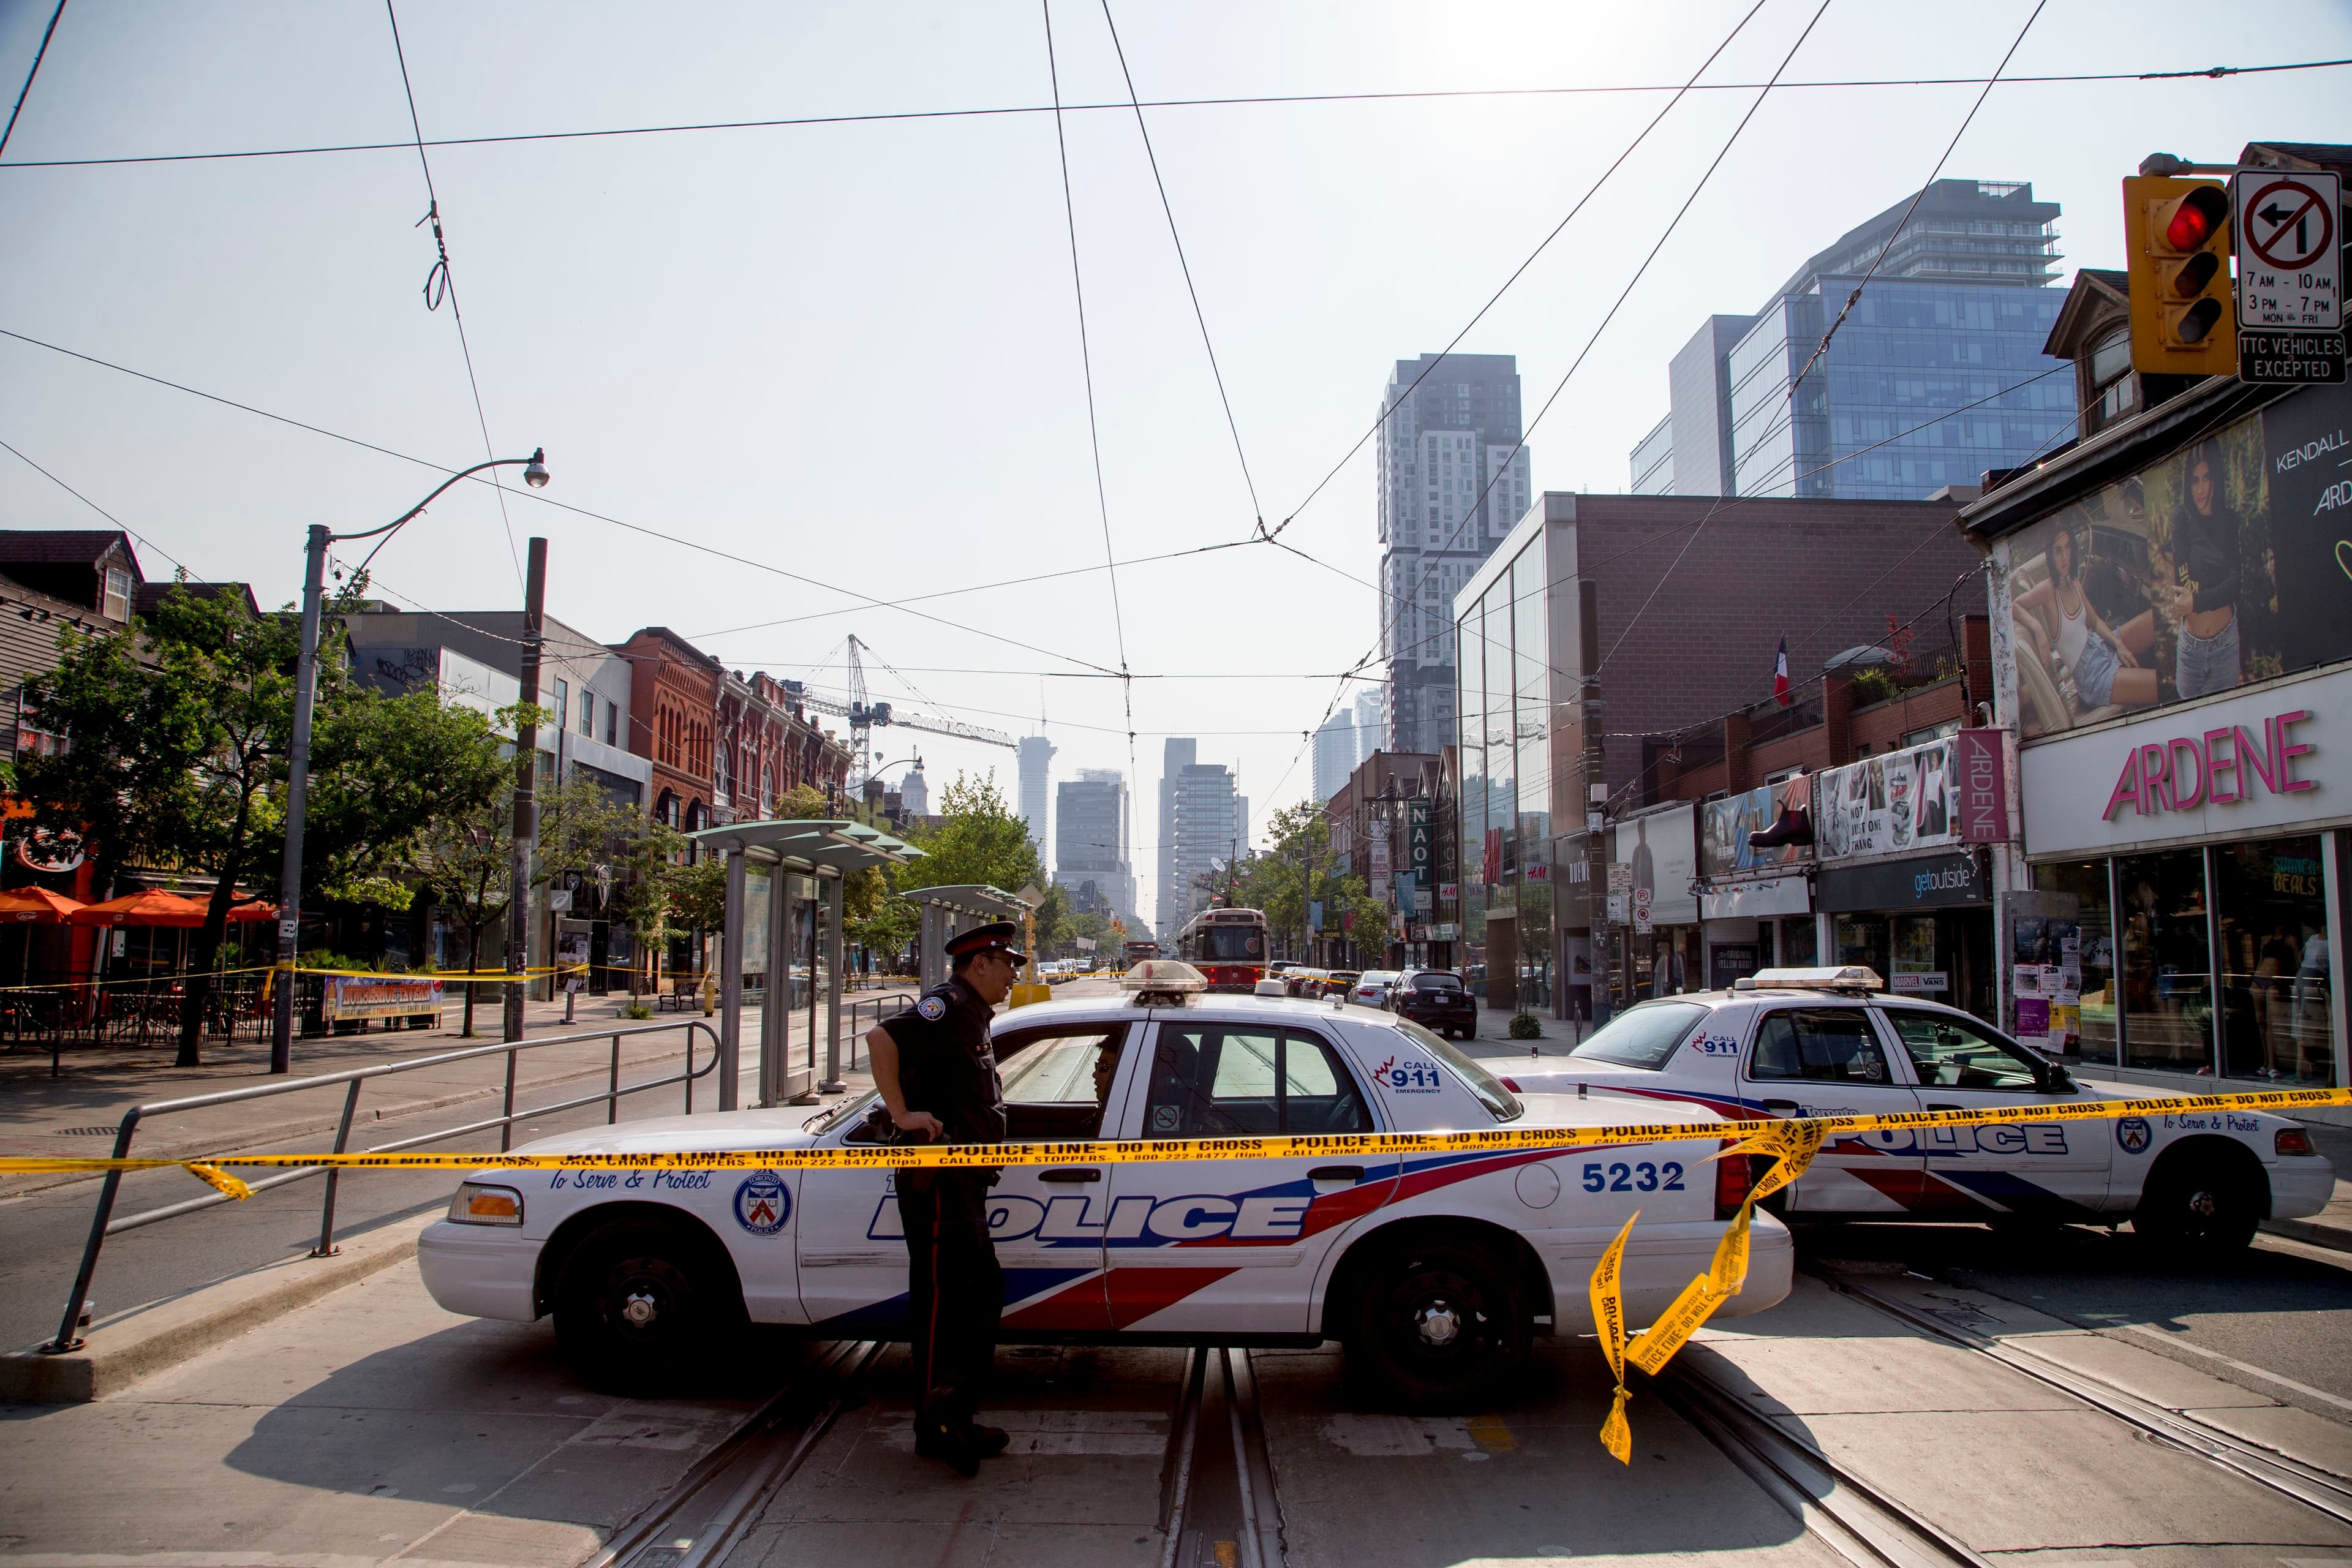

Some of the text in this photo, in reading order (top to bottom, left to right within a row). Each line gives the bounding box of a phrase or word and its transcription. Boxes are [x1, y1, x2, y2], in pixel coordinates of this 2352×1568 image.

[2247, 273, 2255, 287] 7
[2260, 276, 2274, 287] AM
[2298, 274, 2312, 288] 10
[2249, 295, 2257, 309] 3
[2262, 299, 2276, 310] PM
[2301, 297, 2308, 311] 7
[2315, 301, 2329, 312] PM
[2263, 314, 2318, 323] MON FRI
[2241, 337, 2343, 355] TTC VEHICLES
[2255, 360, 2330, 377] EXCEPTED
[2276, 429, 2350, 473] KENDALL
[2102, 710, 2320, 821] ARDENE
[1969, 736, 1996, 838] ARDENE
[1850, 806, 1863, 819] NOT
[1852, 819, 1881, 835] JUST ONE
[1414, 809, 1427, 880] NAOT
[1852, 838, 1874, 851] THING.
[1915, 864, 1970, 899] getoutside
[2274, 873, 2316, 895] DEALS
[1727, 951, 1752, 959] ORIGINAL
[1894, 976, 1944, 987] MARVEL VANS
[343, 984, 431, 1006] HORSESHOE TAVERN
[1391, 1069, 1440, 1087] 9-1-1
[2124, 1091, 2332, 1110] POLICE LINE- DO NOT CROSS
[1802, 1105, 1860, 1117] Toronto
[1875, 1112, 1939, 1124] POLICE
[1998, 1108, 2018, 1117] DO
[2024, 1107, 2051, 1116] NOT
[2057, 1103, 2105, 1114] CROSS
[1602, 1123, 1676, 1137] POLICE
[1679, 1123, 1731, 1134] LINE-
[1738, 1121, 1760, 1131] DO
[2179, 1114, 2206, 1129] Serve
[2211, 1116, 2222, 1129] &
[2226, 1115, 2259, 1132] Protect
[1291, 1128, 1577, 1148] POLICE LINE- DO NOT CROSS
[1449, 1140, 1547, 1151] 1-800-222-8477
[1551, 1139, 1580, 1148] (tips)
[1627, 1135, 1667, 1144] CRIME
[1820, 1123, 2068, 1155] POLICE
[756, 1150, 784, 1159] DO
[796, 1150, 837, 1158] NOT
[845, 1147, 916, 1157] CROSS
[947, 1139, 1263, 1156] POLICE LINE- DO NOT CROSS
[1120, 1152, 1229, 1161] 1-800-222-8477
[1235, 1150, 1267, 1159] (tips)
[886, 1158, 921, 1167] (tips)
[573, 1169, 617, 1189] Serve
[625, 1170, 644, 1188] &
[654, 1169, 715, 1189] Protect
[748, 1175, 780, 1185] TORONTO
[1582, 1162, 1685, 1193] 5232
[1758, 1173, 1781, 1192] CROSS
[751, 1225, 774, 1234] POLICE
[1605, 1252, 1618, 1283] CROSS
